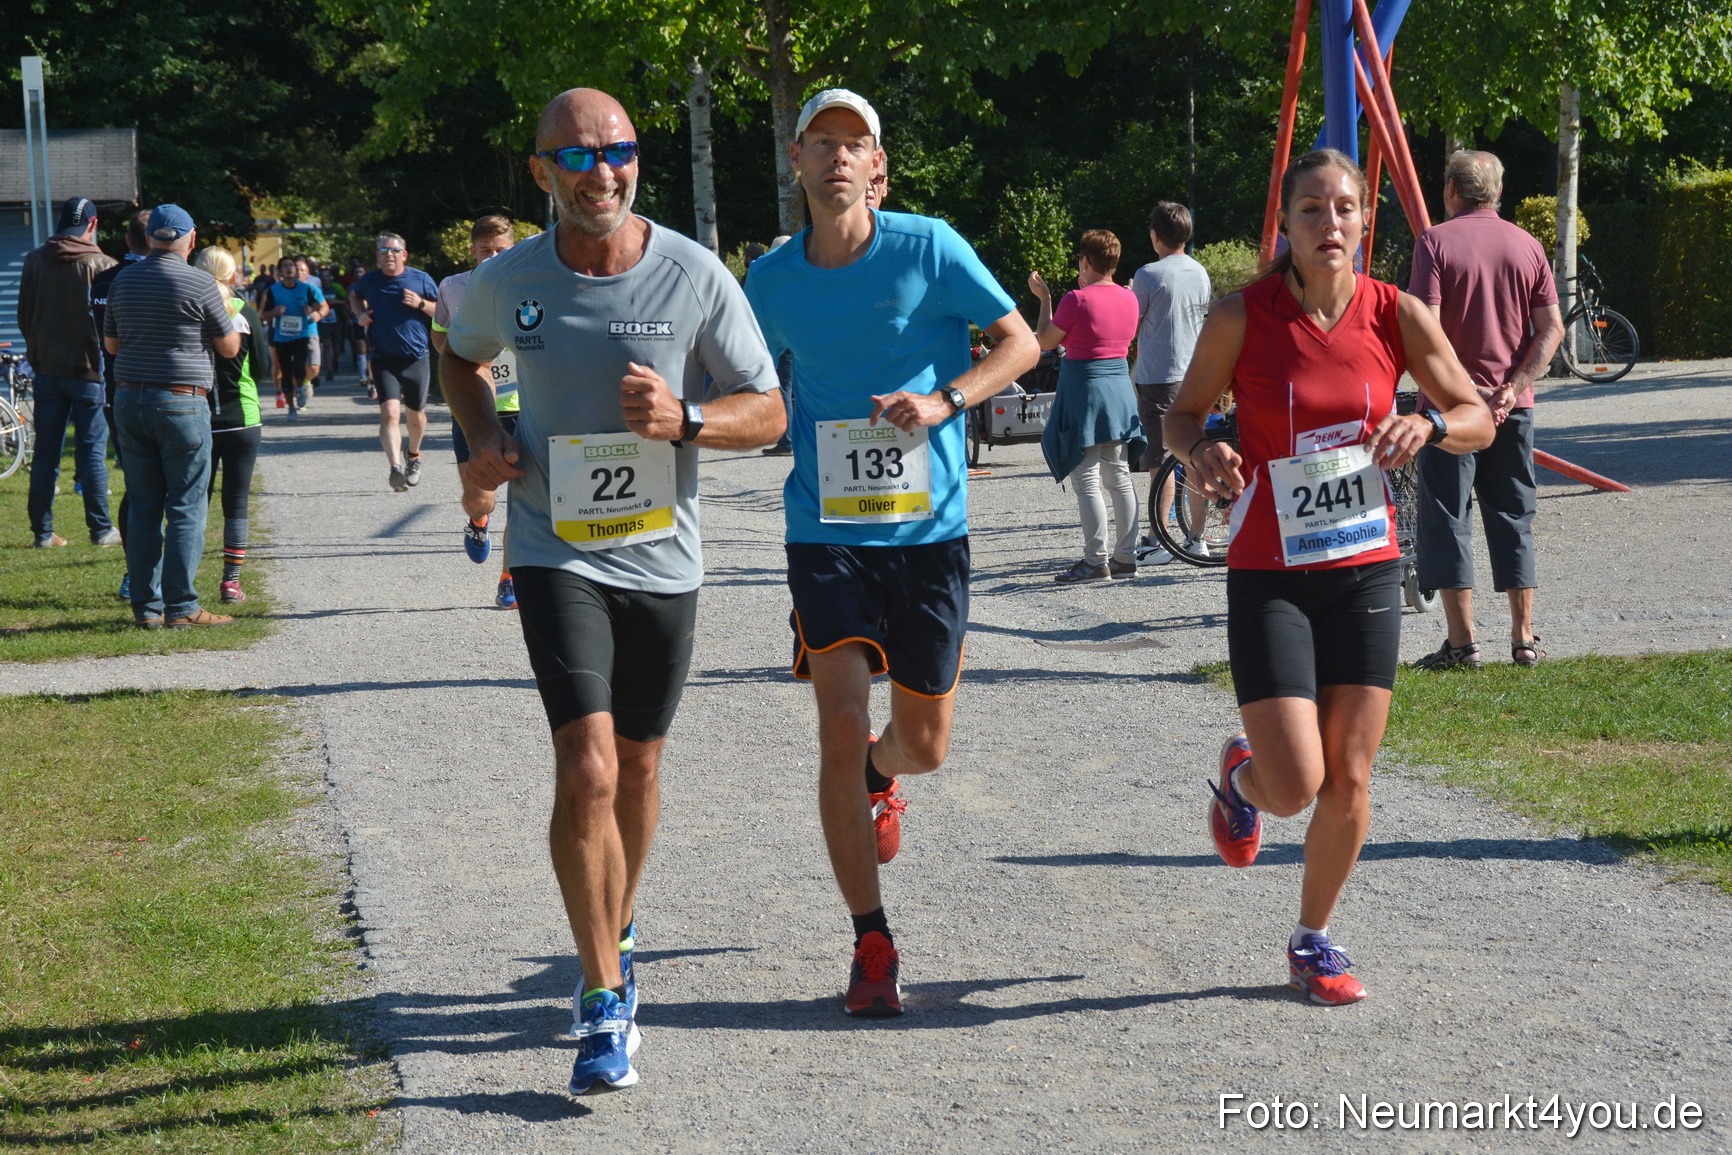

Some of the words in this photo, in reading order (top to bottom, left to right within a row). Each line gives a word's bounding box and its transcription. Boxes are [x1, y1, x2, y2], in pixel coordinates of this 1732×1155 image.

[609, 321, 674, 335] BOCK
[515, 335, 545, 345] PARTL
[1017, 412, 1040, 420] TULE
[848, 427, 897, 440] BOCK
[1314, 430, 1343, 444] DEHN
[584, 443, 640, 458] BOCK
[846, 447, 904, 480] 133
[1304, 457, 1350, 475] BOCK
[591, 466, 636, 502] 22
[867, 484, 900, 492] Neumarkt
[1292, 474, 1366, 518] 2441
[578, 506, 605, 515] PARTL
[606, 503, 642, 514] Neumarkt
[858, 498, 896, 513] Oliver
[587, 519, 644, 538] Thomas
[1304, 519, 1328, 529] PARTL
[1329, 513, 1359, 525] Neumarkt
[1298, 525, 1377, 552] Anne-Sophie
